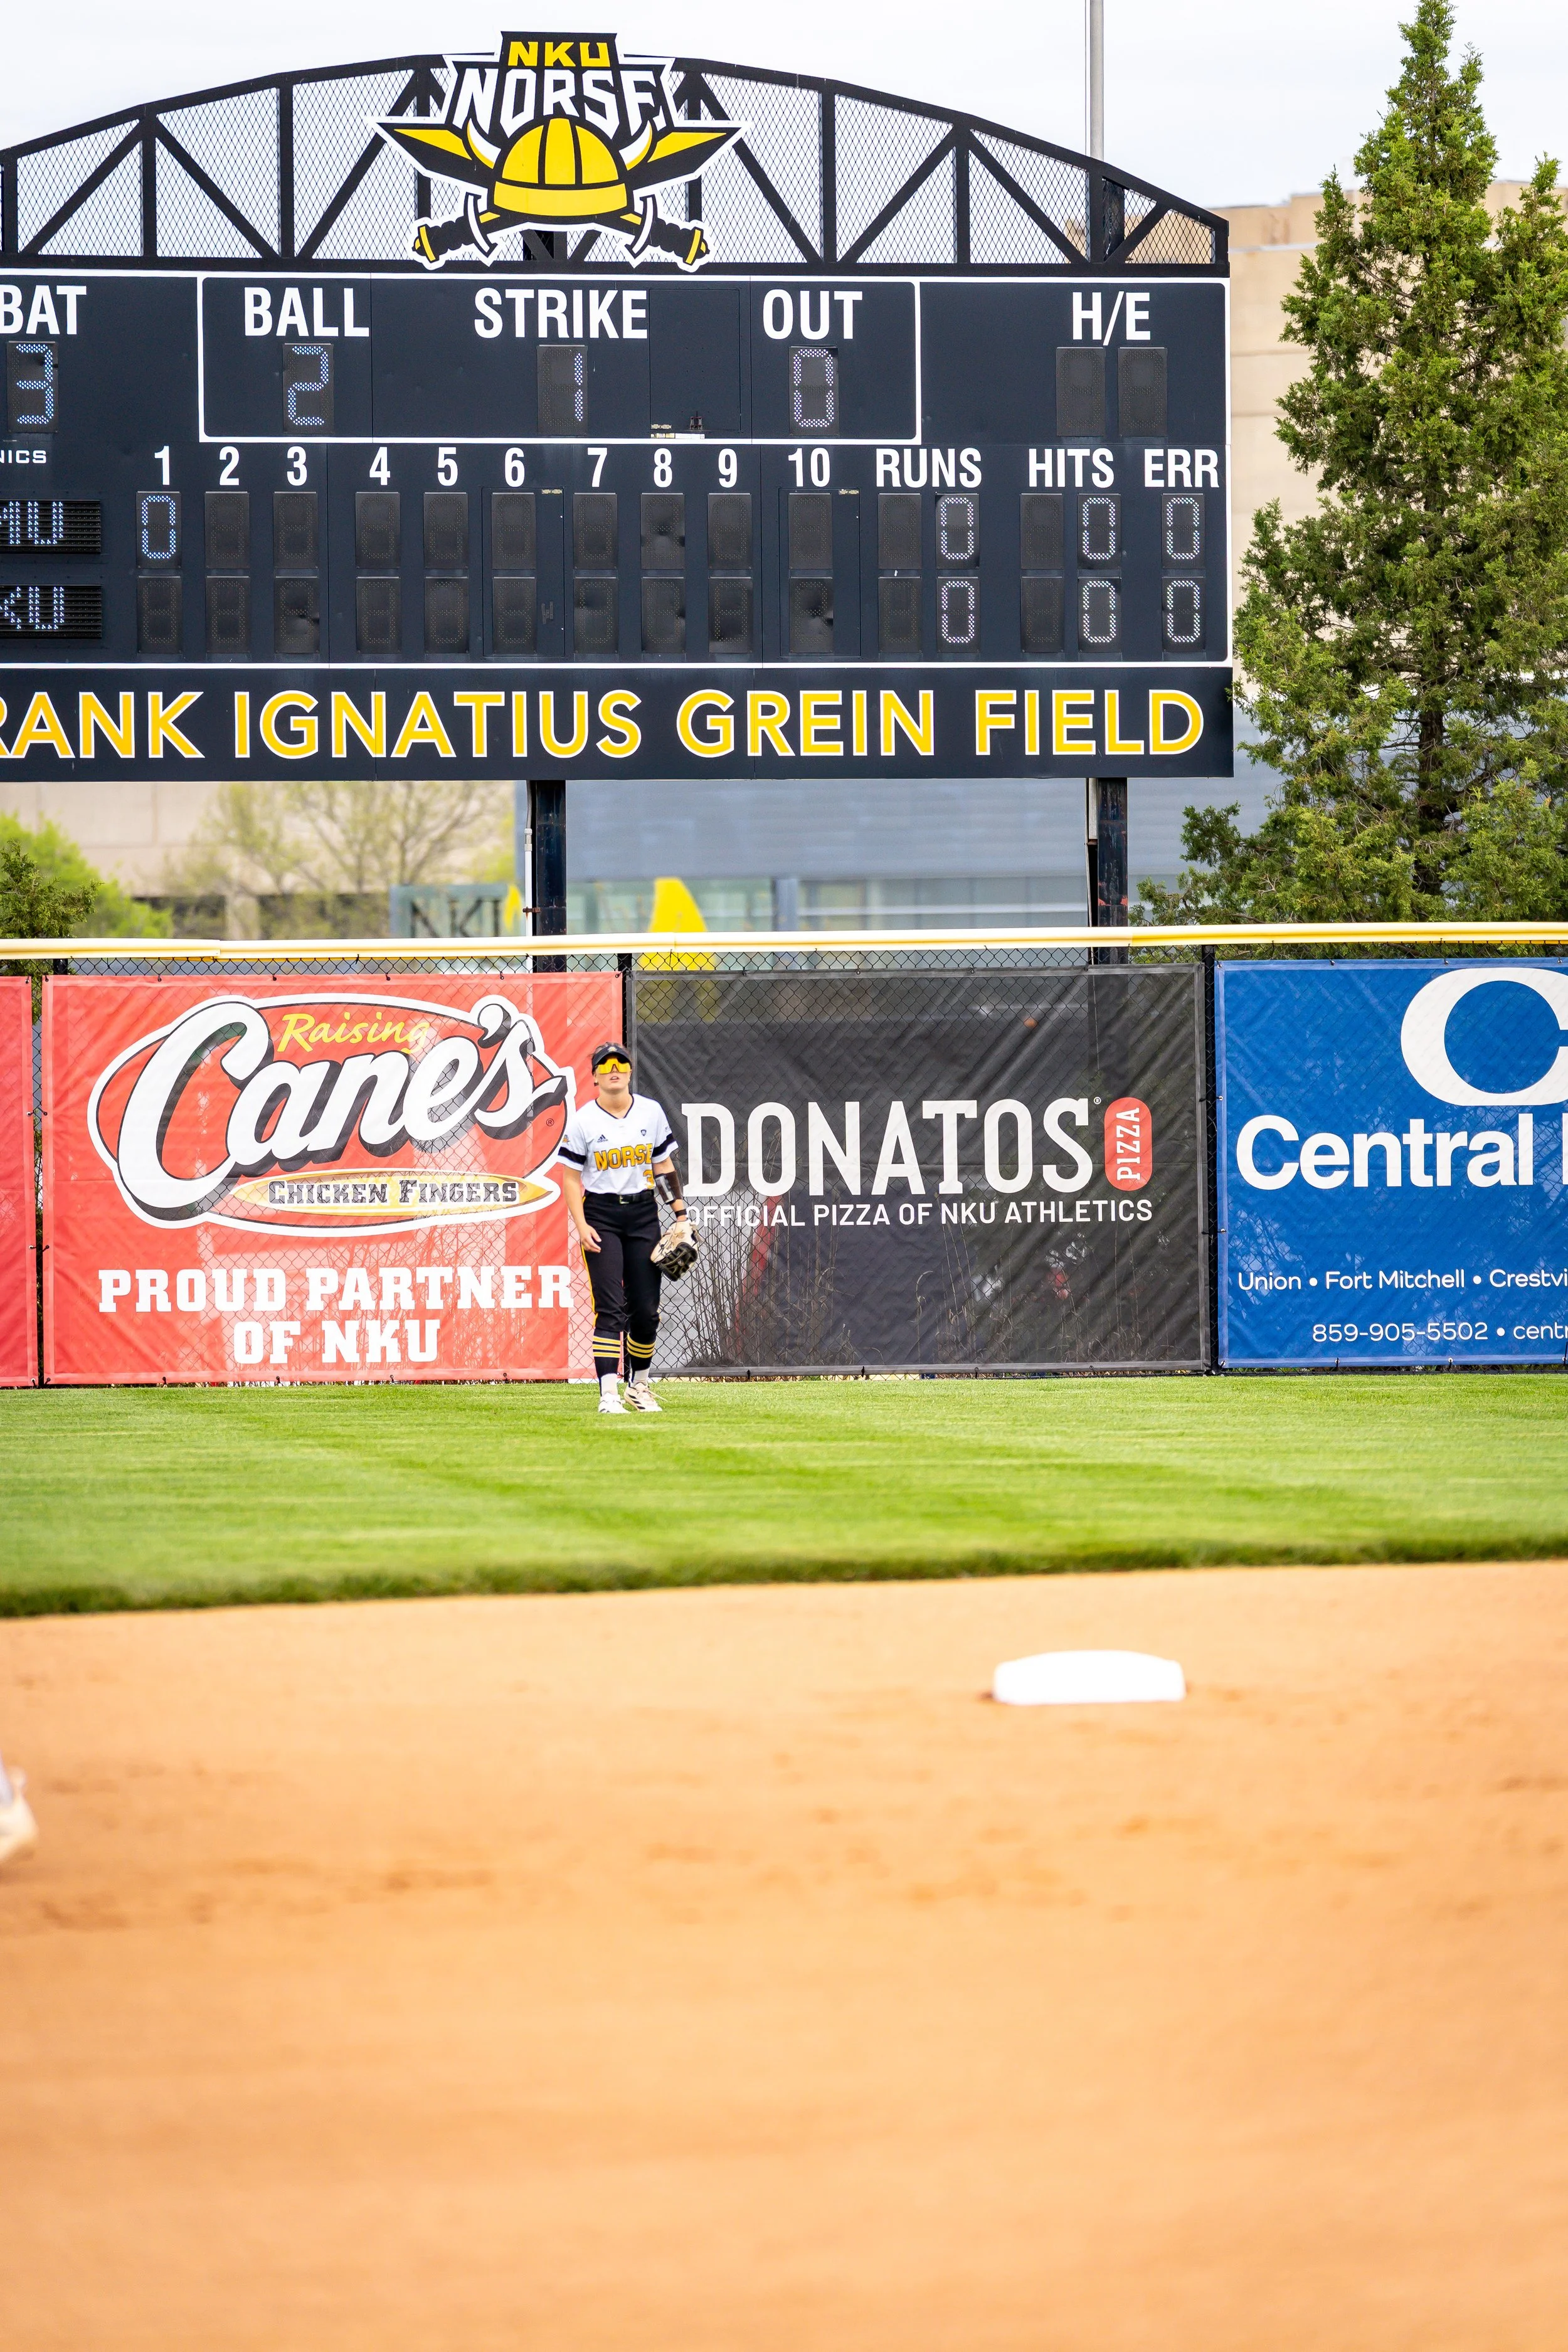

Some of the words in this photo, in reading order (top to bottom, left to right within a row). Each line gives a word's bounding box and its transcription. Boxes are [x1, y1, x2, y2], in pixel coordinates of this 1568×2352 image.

[508, 41, 610, 67] NKU
[453, 68, 665, 139] NORSE
[0, 285, 87, 334] BAT
[245, 287, 369, 337] BALL
[475, 288, 647, 339] STRIKE
[763, 289, 862, 339] OUT
[1073, 291, 1150, 346] H/E
[16, 344, 53, 424] 3
[287, 346, 329, 426] 2
[575, 353, 583, 421] 1
[793, 349, 834, 427] 0
[155, 446, 170, 485] 1
[220, 447, 239, 485] 2
[287, 447, 308, 485] 3
[369, 447, 390, 485] 4
[438, 447, 458, 485] 5
[505, 448, 524, 487] 6
[588, 448, 607, 487] 7
[654, 448, 673, 487] 8
[719, 448, 738, 487] 9
[788, 448, 830, 487] 10
[876, 448, 982, 487] RUNS
[1029, 448, 1114, 488] HITS
[1145, 449, 1219, 487] ERR
[142, 495, 176, 559] 0
[940, 497, 974, 560] 0
[1082, 497, 1115, 560] 0
[1167, 497, 1199, 560] 0
[941, 581, 975, 644] 0
[1083, 581, 1116, 643] 0
[1167, 580, 1200, 643] 0
[0, 691, 205, 759] ANK
[235, 689, 642, 759] IGNATIUS
[677, 689, 934, 758] GREIN
[975, 689, 1204, 756] FIELD
[277, 1012, 430, 1054] Raising
[118, 1001, 566, 1215] Cane's
[593, 1143, 653, 1171] NORSE
[682, 1098, 1093, 1197] DONATOS
[1116, 1108, 1140, 1180] PIZZA
[1237, 1114, 1533, 1190] Central
[268, 1181, 388, 1204] CHICKEN
[399, 1180, 517, 1202] FINGERS
[686, 1205, 805, 1227] OFFICIAL
[814, 1204, 891, 1226] PIZZA
[899, 1203, 933, 1225] OF
[941, 1202, 996, 1224] NKU
[1004, 1199, 1152, 1224] ATHLETICS
[98, 1269, 287, 1313] PROUD
[306, 1265, 575, 1311] PARTNER
[1239, 1272, 1301, 1290] Union
[1326, 1271, 1373, 1290] Fort
[1379, 1269, 1465, 1288] Mitchell
[233, 1321, 301, 1364] OF
[322, 1320, 439, 1364] NKU
[1313, 1322, 1488, 1342] 859-905-5502
